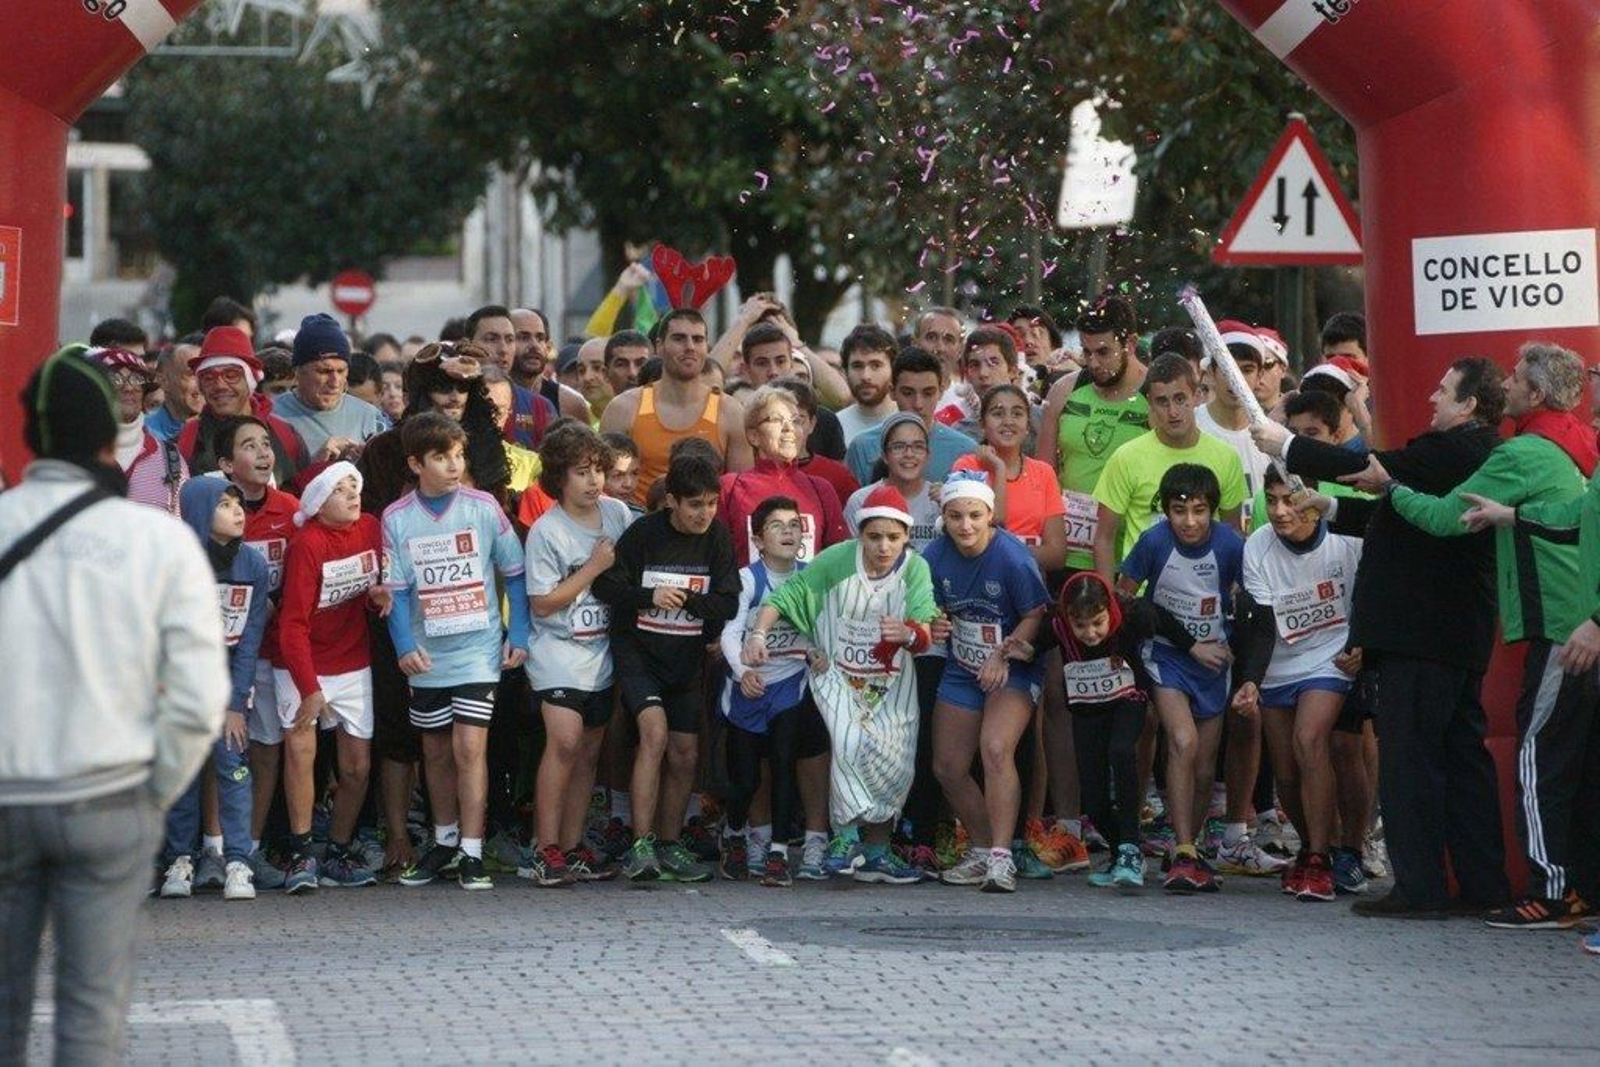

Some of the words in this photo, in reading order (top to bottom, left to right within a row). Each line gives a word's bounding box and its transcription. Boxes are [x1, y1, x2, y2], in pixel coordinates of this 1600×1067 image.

[1424, 250, 1582, 281] CONCELLO
[1441, 287, 1478, 311] DE
[1489, 283, 1564, 308] VIGO
[423, 562, 474, 585] 0724
[1286, 604, 1336, 630] 0228
[1075, 675, 1123, 695] 0191
